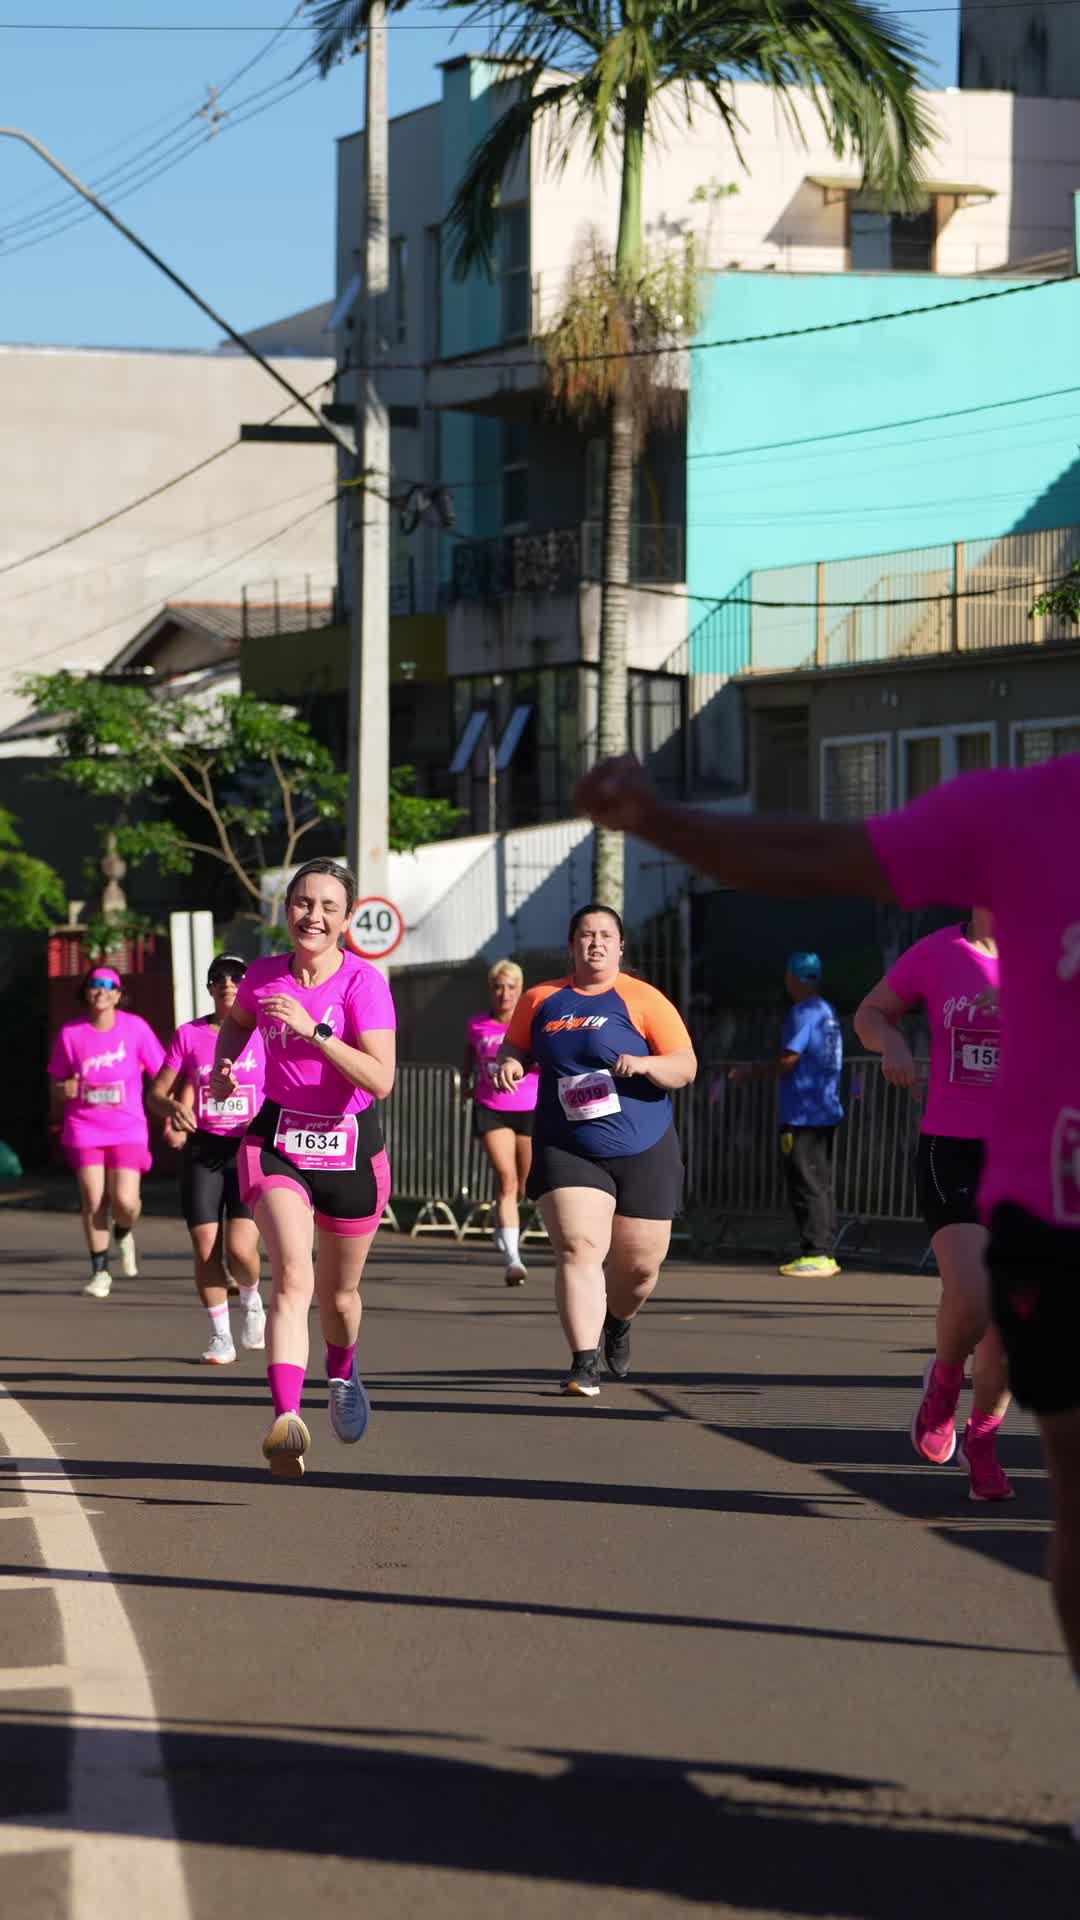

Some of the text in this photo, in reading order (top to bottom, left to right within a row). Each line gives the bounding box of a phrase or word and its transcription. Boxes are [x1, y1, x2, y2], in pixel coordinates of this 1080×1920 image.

[356, 911, 392, 932] 40
[567, 1086, 602, 1105] 2019
[213, 1099, 244, 1112] 1796
[294, 1132, 339, 1150] 1634
